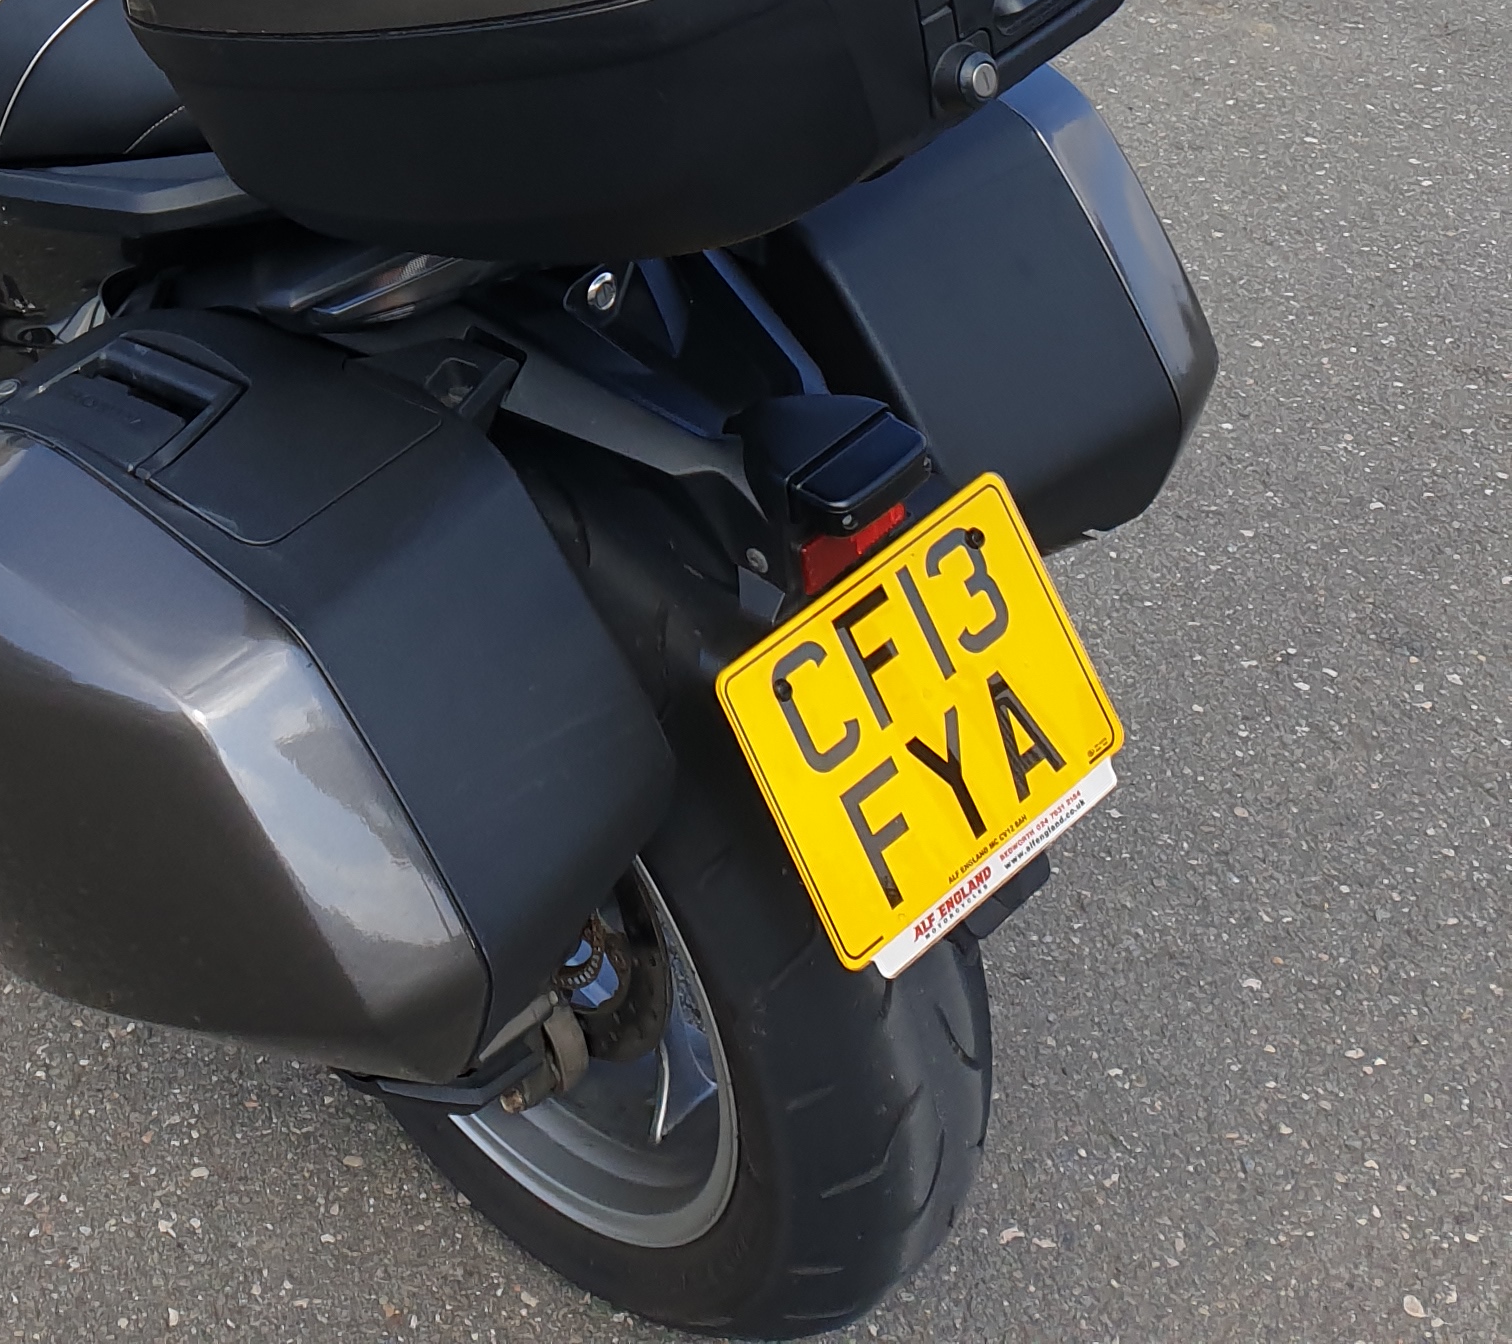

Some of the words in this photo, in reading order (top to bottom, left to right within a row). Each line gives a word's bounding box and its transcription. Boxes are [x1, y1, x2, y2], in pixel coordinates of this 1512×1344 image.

[772, 527, 1009, 773] CF13
[840, 671, 1067, 910] FYA
[914, 912, 935, 943] ALF
[936, 866, 992, 921] ENGLAND
[925, 884, 988, 939] MOTORCYCLES
